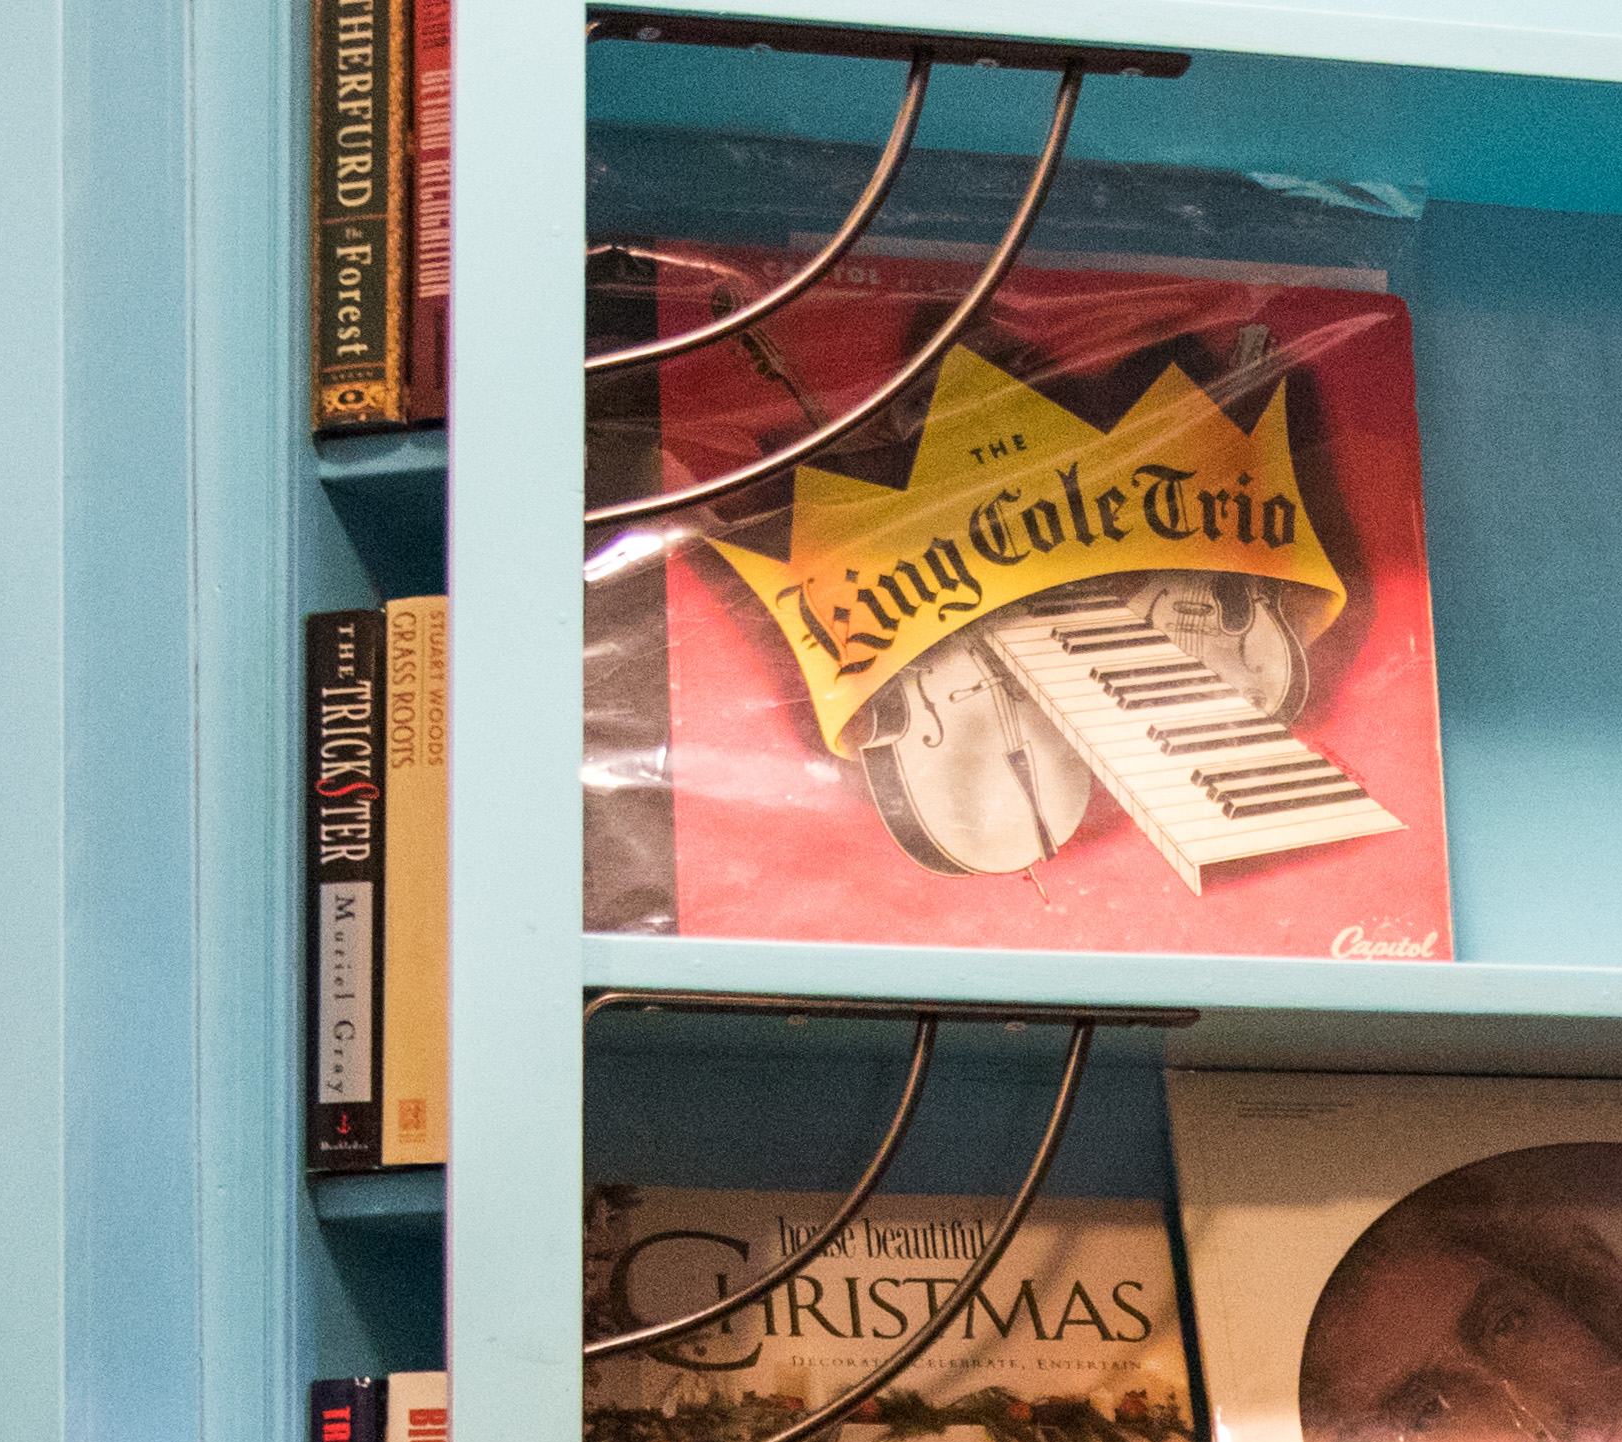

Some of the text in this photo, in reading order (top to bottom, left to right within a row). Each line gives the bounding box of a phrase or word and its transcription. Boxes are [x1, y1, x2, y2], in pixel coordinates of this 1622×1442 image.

[337, 244, 372, 356] Forest
[970, 436, 1027, 466] THE
[776, 462, 1297, 682] King Cole Trio
[316, 623, 380, 865] THE TRICKSTER
[1331, 925, 1439, 962] Capitol
